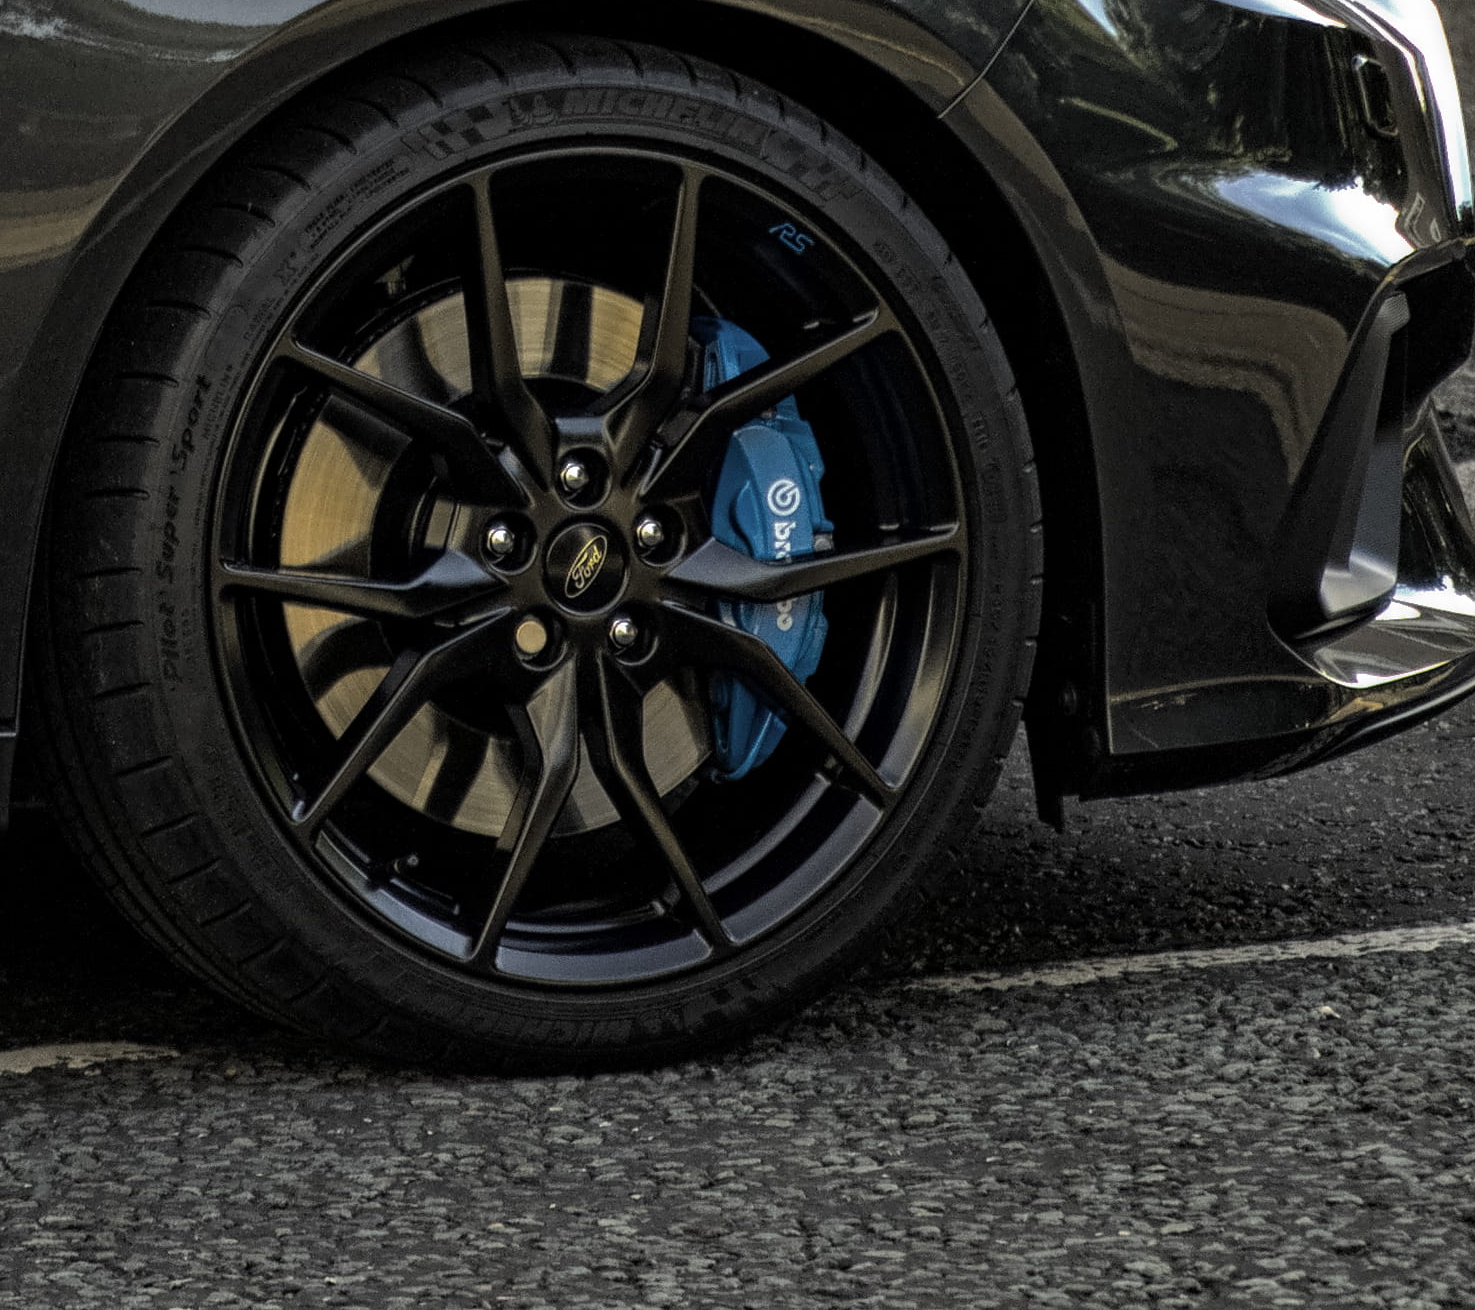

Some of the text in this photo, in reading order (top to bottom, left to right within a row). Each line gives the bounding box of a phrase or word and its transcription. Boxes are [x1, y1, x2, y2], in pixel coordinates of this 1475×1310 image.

[560, 86, 767, 154] MICHELIN
[769, 222, 815, 254] RS
[157, 373, 212, 684] Pilot Super Sport
[571, 543, 604, 589] Ford
